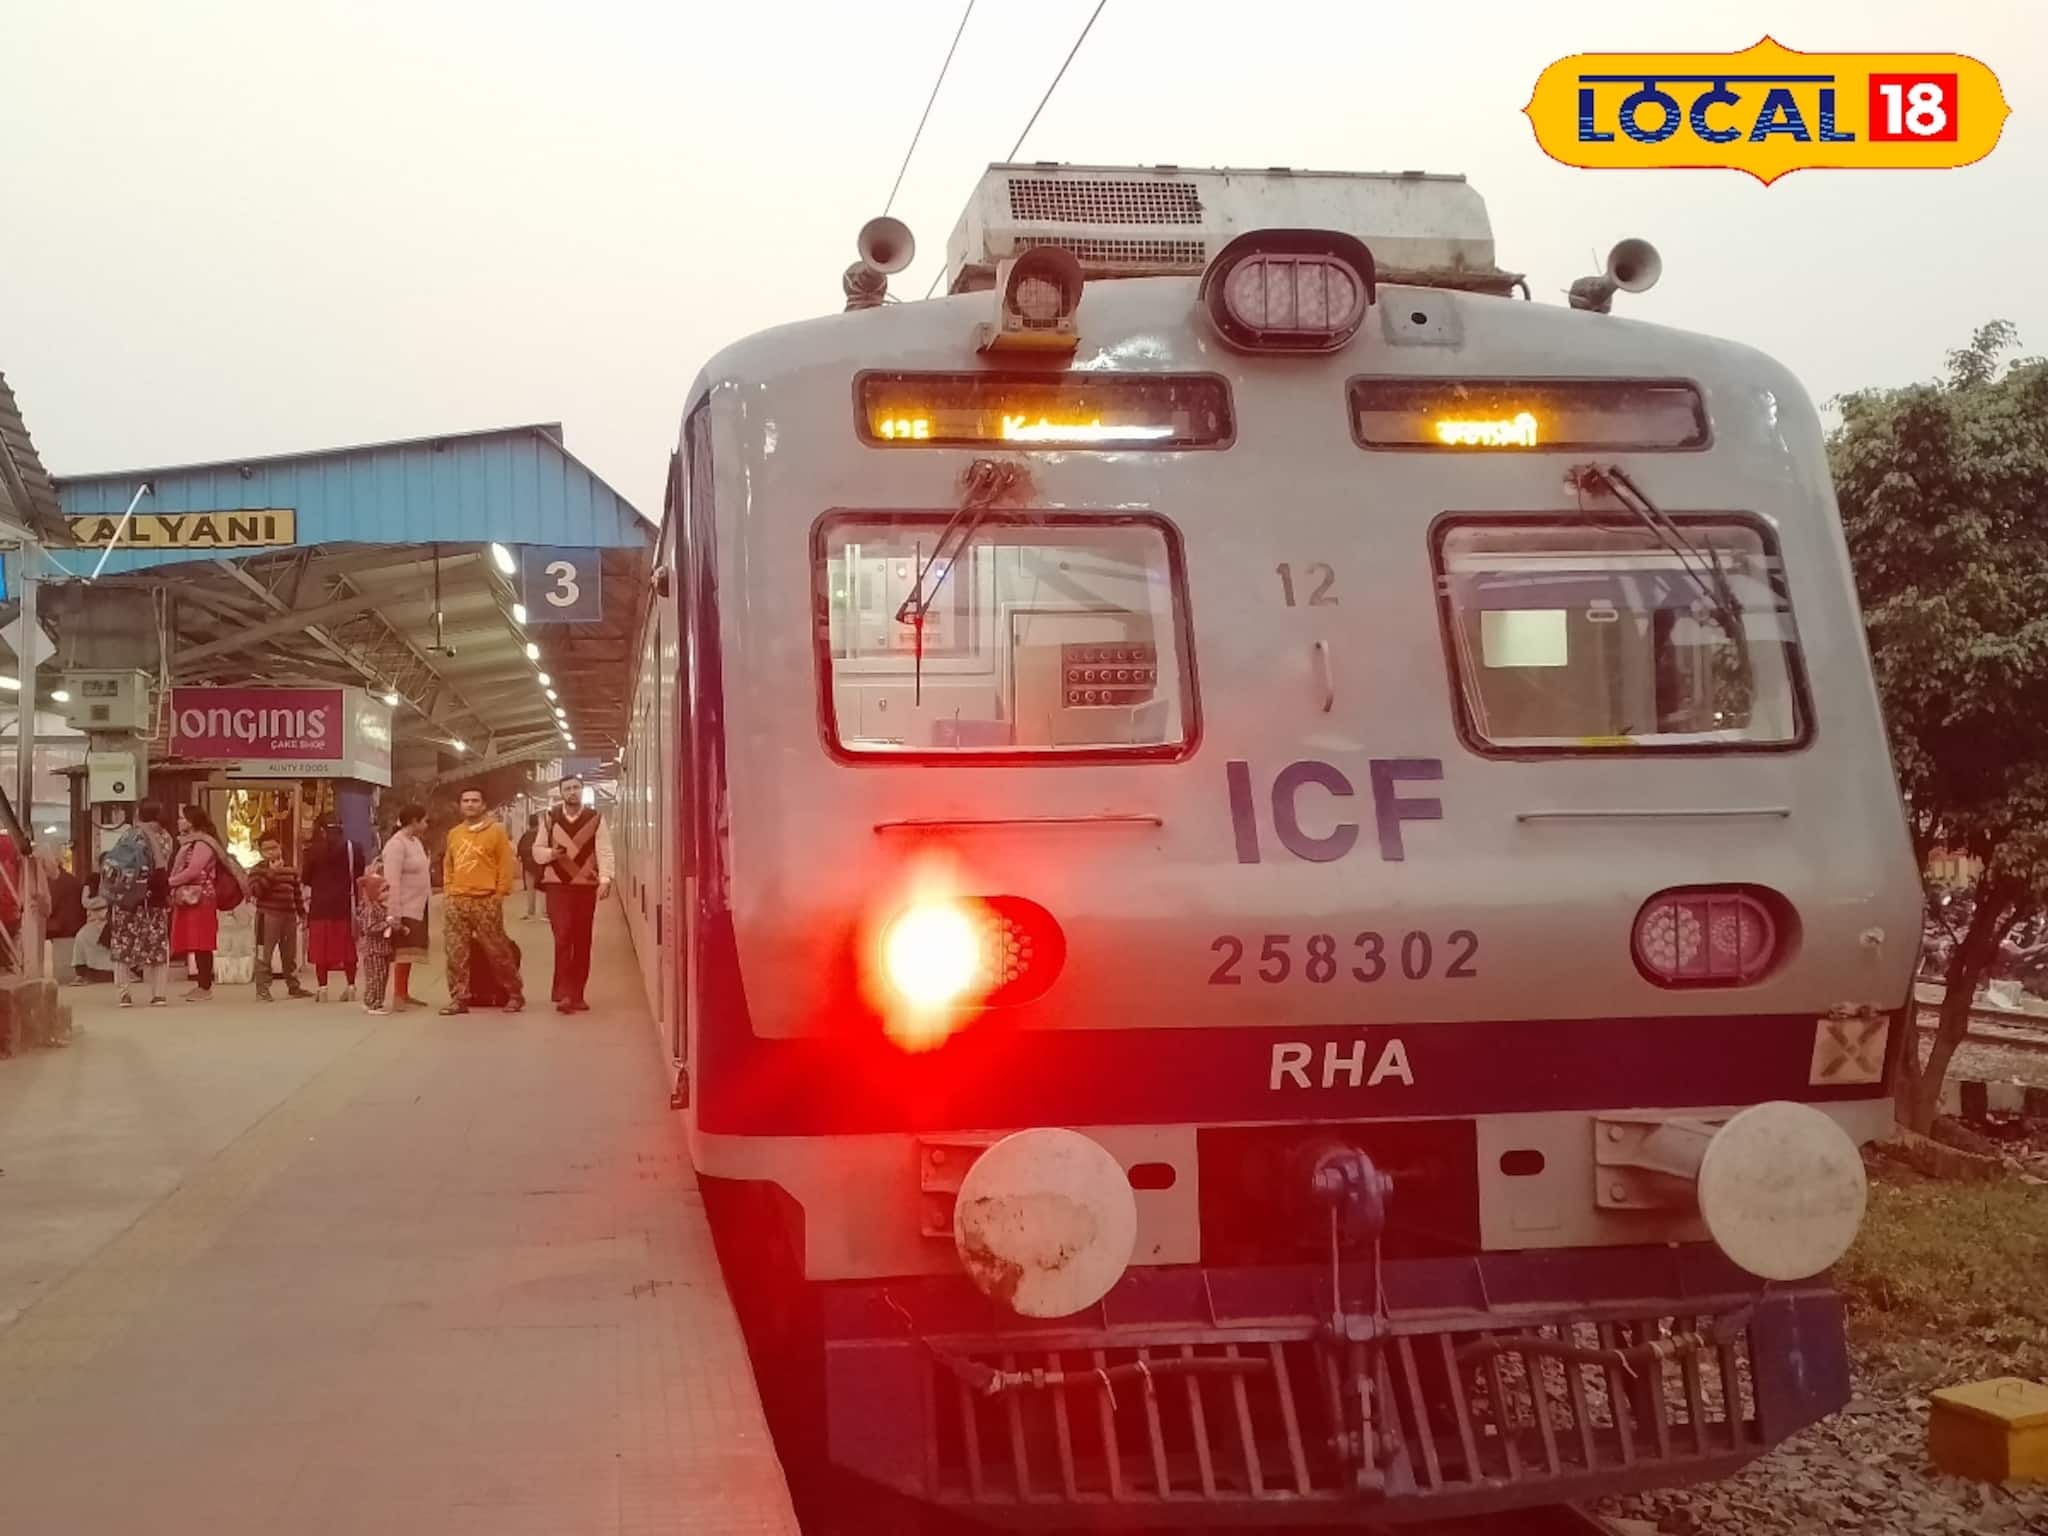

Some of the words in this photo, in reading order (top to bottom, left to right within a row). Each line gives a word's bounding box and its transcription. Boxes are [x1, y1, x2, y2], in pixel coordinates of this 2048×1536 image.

[545, 560, 580, 608] 3
[1276, 562, 1339, 608] 12
[1225, 758, 1445, 864] ICF
[1207, 929, 1480, 986] 258302
[1269, 1038, 1415, 1090] RHA
